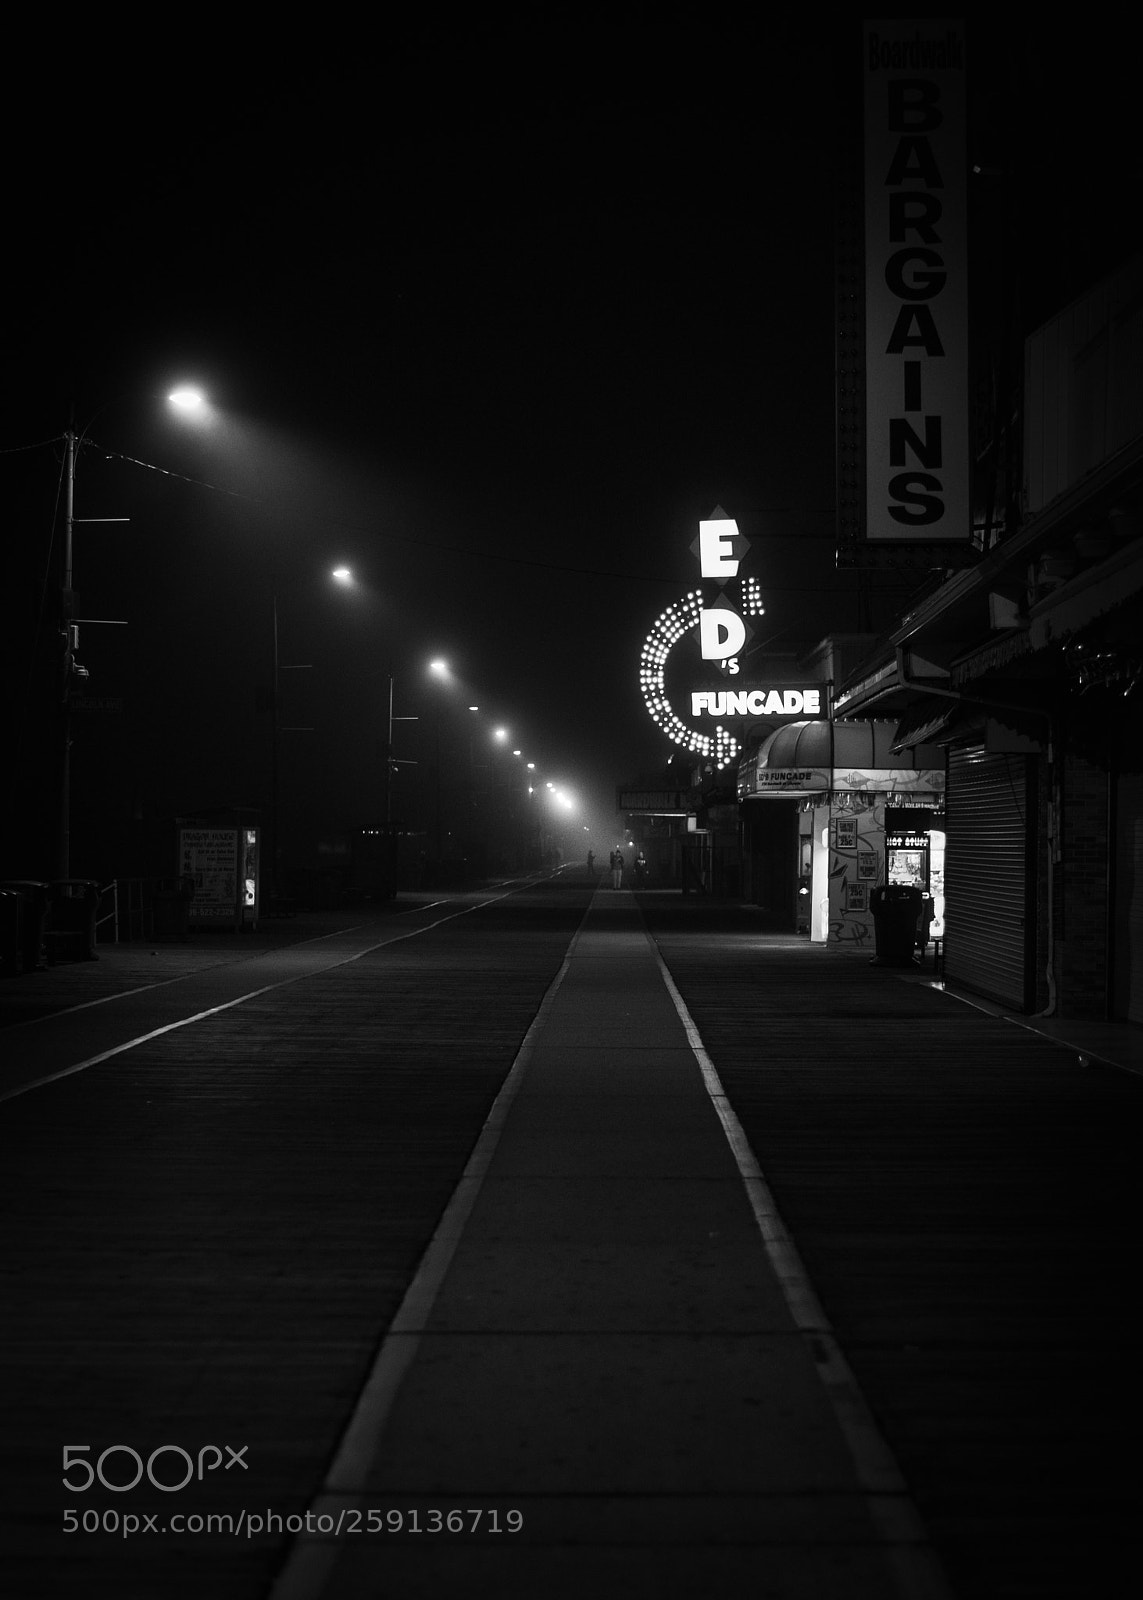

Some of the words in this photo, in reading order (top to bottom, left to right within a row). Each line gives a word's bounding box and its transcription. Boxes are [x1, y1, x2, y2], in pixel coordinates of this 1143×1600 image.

[868, 31, 963, 71] Boardwalk
[884, 79, 946, 526] BARGAINS
[691, 690, 820, 716] FUNCADE
[770, 772, 812, 780] FUNCADE
[886, 837, 903, 846] HOT
[904, 837, 929, 846] STUFF
